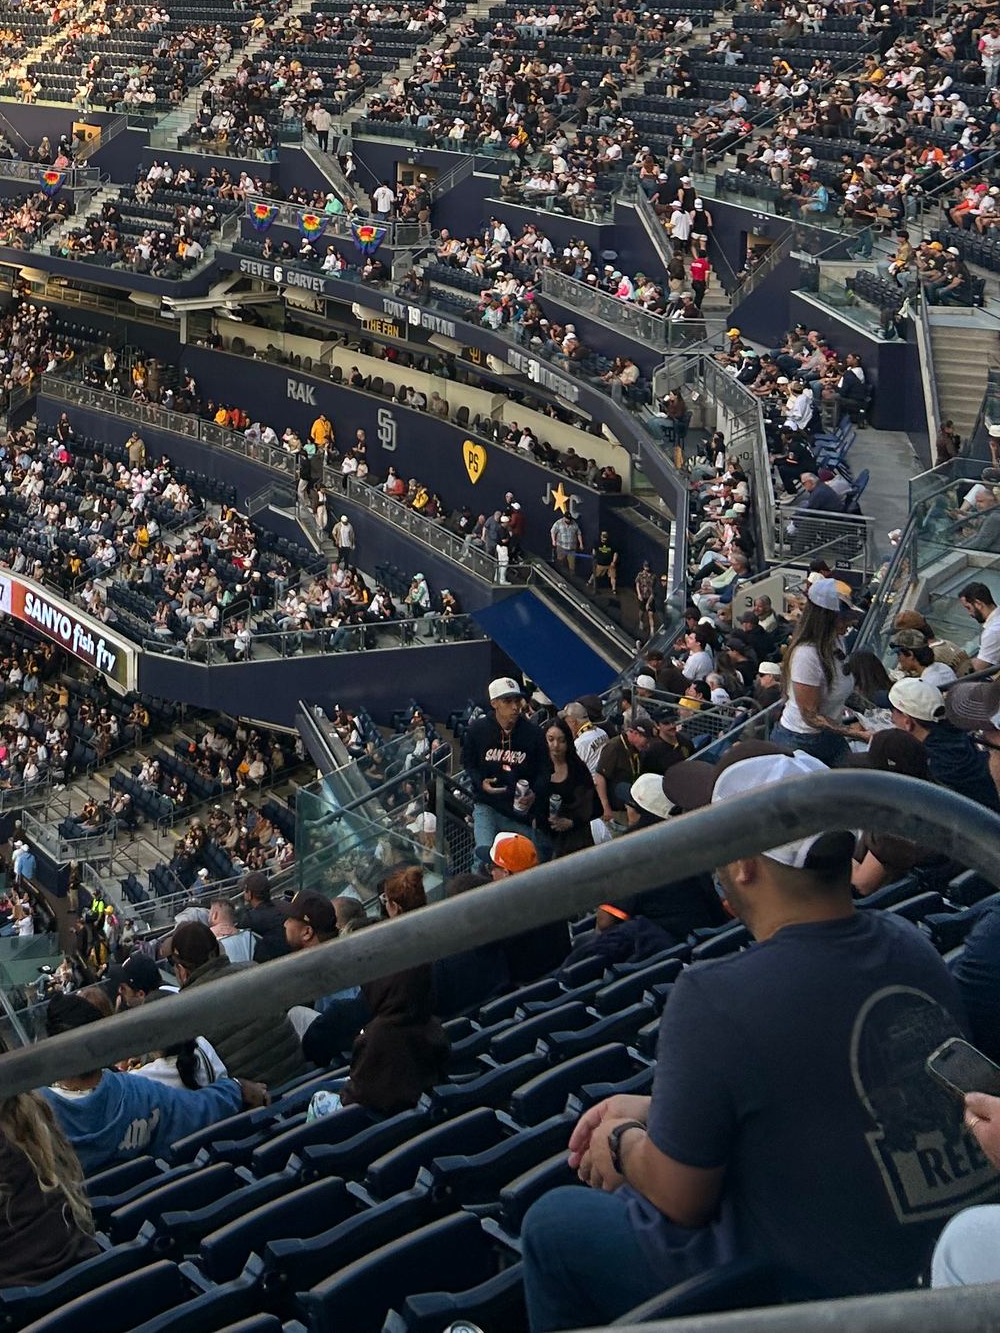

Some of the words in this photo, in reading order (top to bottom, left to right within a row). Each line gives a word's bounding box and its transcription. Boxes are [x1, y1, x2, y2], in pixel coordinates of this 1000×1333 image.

[240, 259, 270, 278] STEVE
[273, 267, 282, 282] 6
[287, 272, 325, 292] GARVEY
[365, 318, 382, 332] THE
[382, 322, 399, 338] FAN
[383, 298, 404, 316] TONY
[407, 306, 421, 326] 19
[422, 312, 456, 338] GWYNN
[287, 378, 317, 406] RAK
[468, 451, 478, 473] PS
[24, 592, 72, 640] SANYO
[73, 623, 94, 655] fish
[96, 638, 116, 672] fry
[485, 748, 503, 762] SAN
